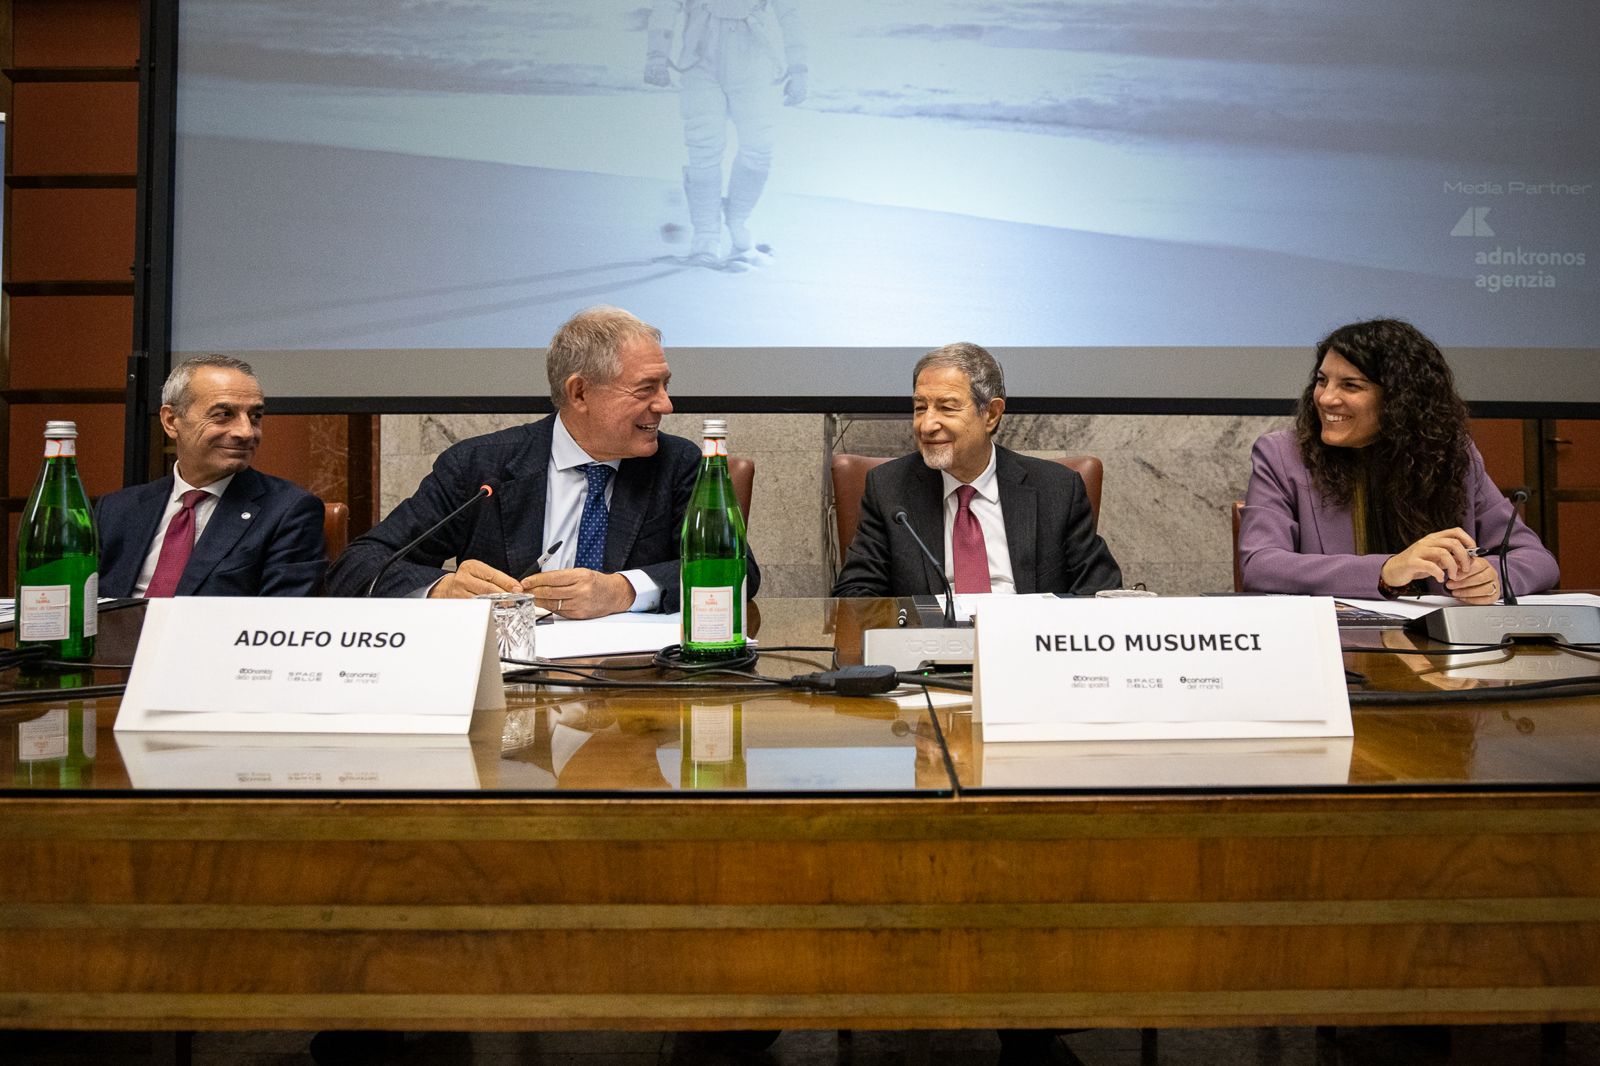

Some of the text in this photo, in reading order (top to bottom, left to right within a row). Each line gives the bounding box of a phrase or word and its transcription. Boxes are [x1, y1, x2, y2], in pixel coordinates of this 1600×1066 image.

[1444, 181, 1592, 194] Media Partner
[1475, 247, 1586, 265] adnkronos
[1475, 271, 1555, 292] agenzia
[234, 630, 406, 648] ADOLFO URSO
[1035, 633, 1262, 652] NELLO MUSUMECI
